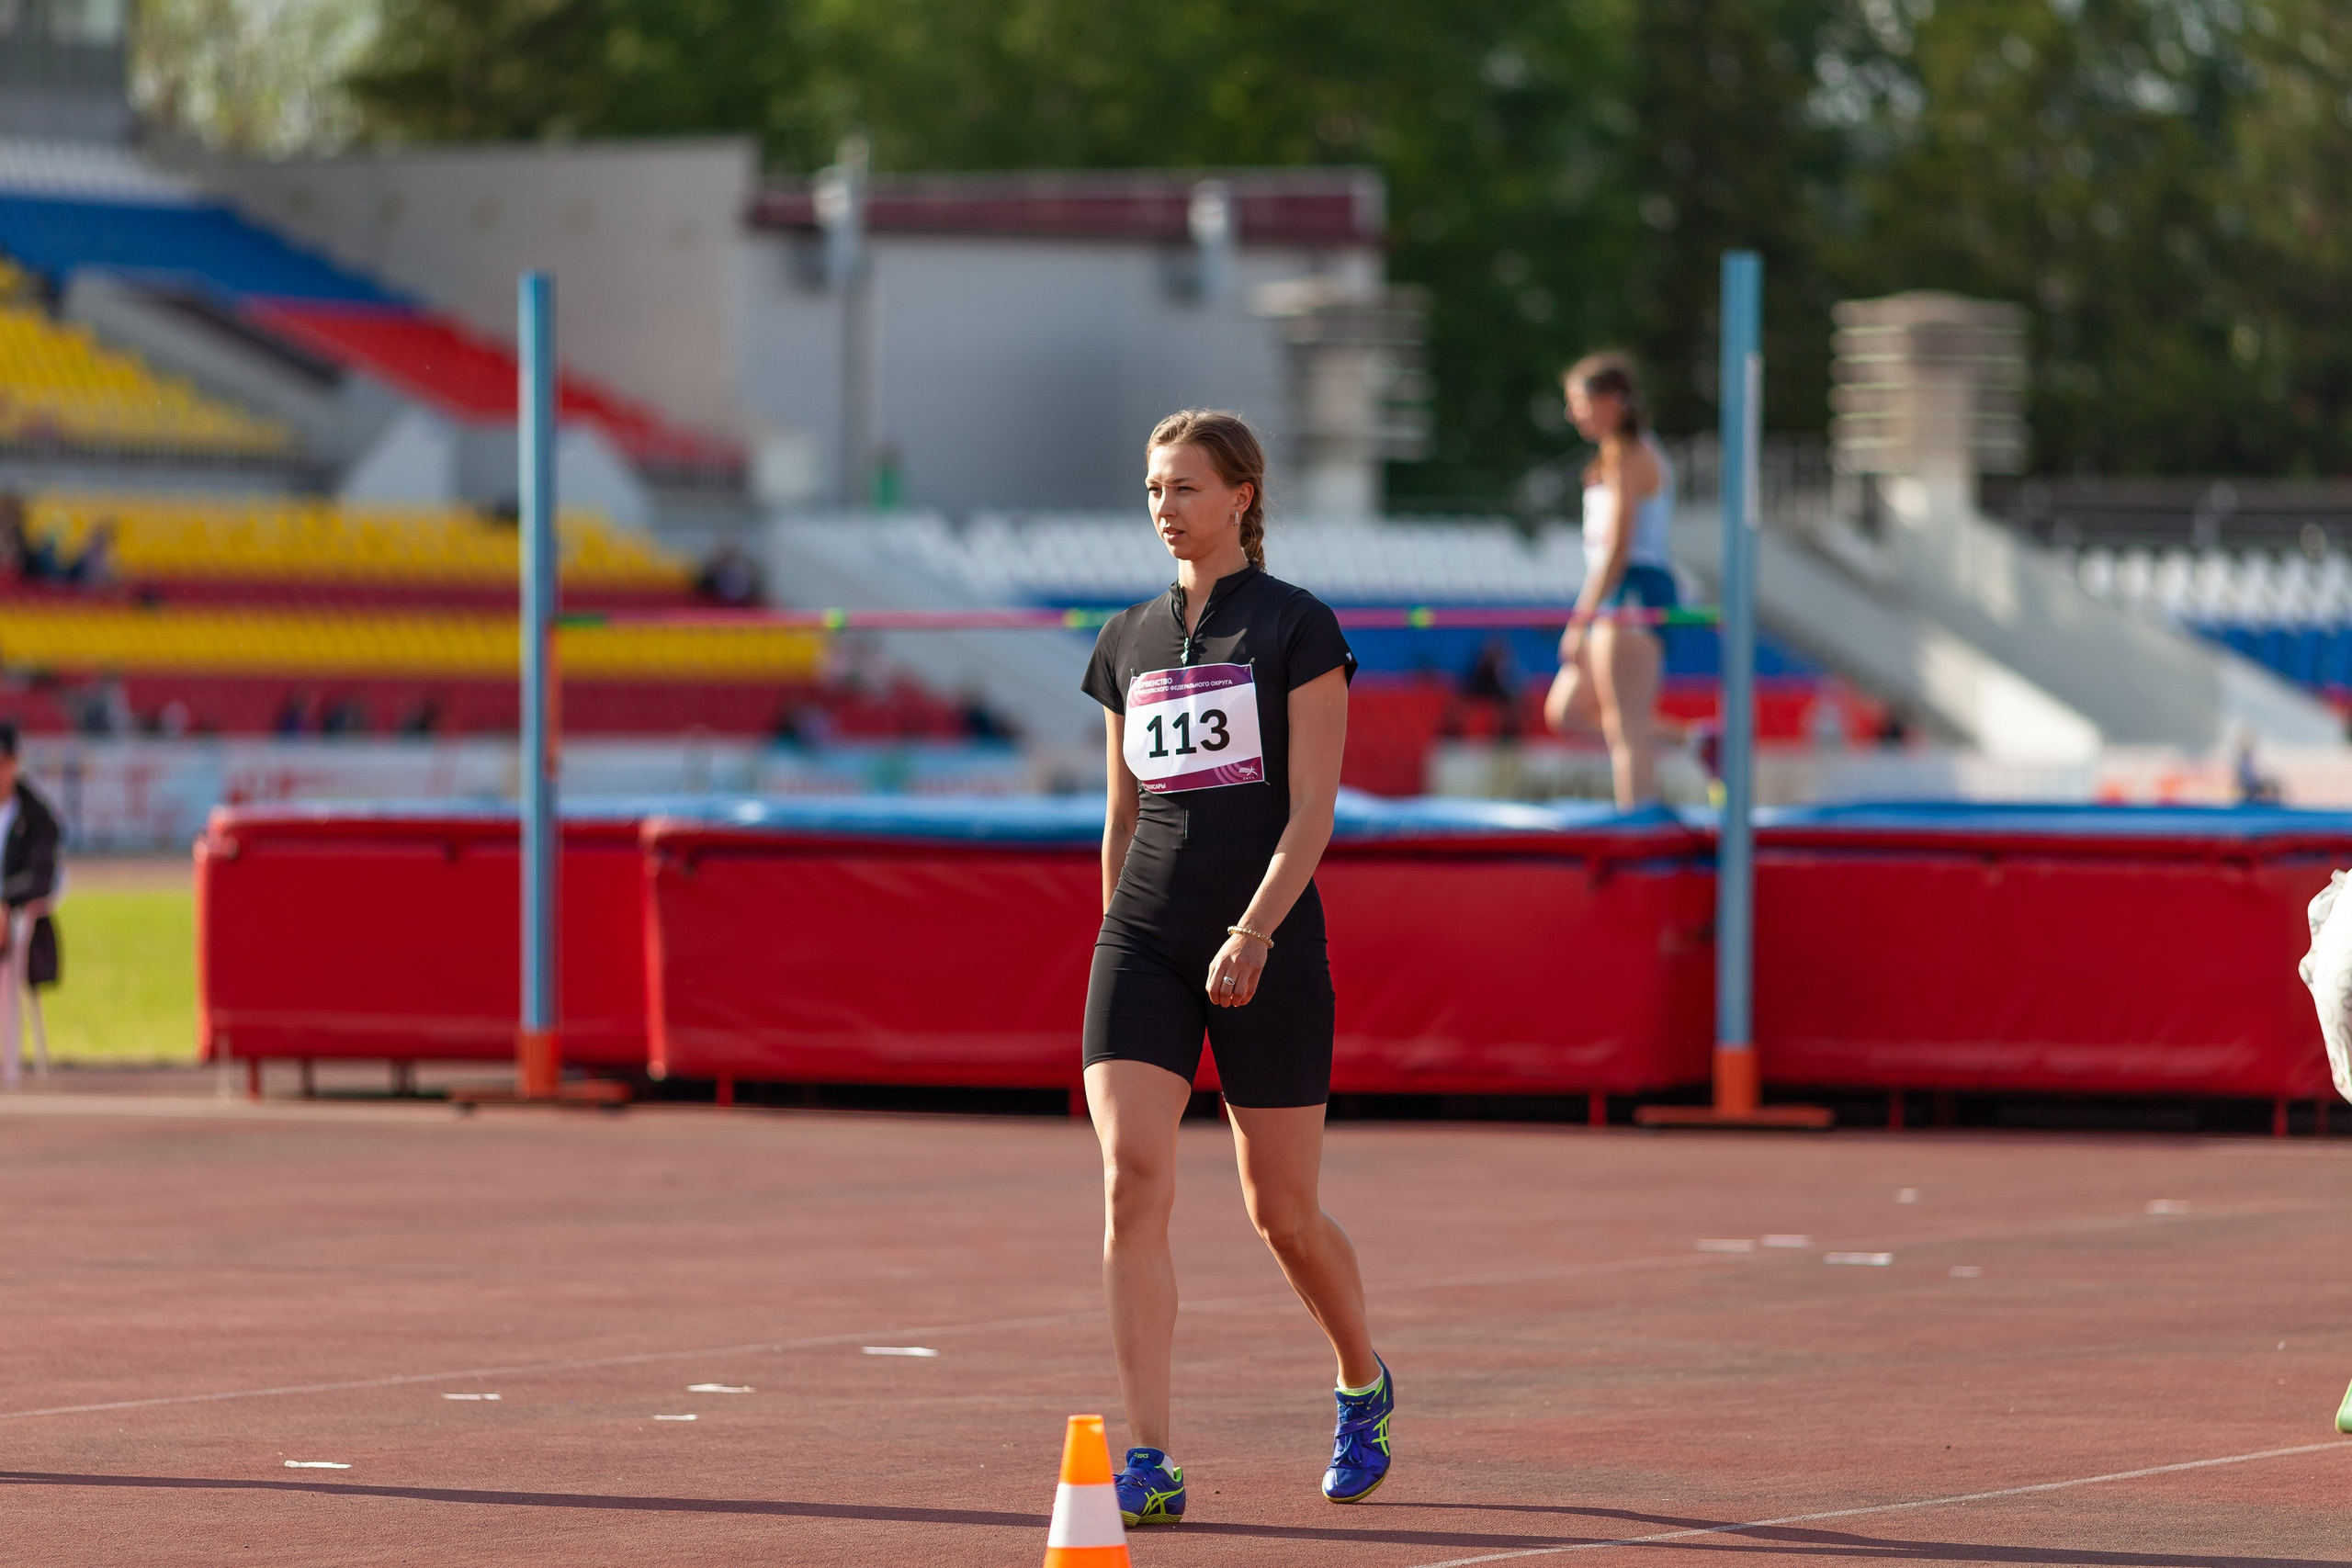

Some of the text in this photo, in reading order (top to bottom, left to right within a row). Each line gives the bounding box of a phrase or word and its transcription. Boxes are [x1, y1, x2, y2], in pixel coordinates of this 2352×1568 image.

[1170, 680, 1210, 691] ФЕДЕРАЛЬНОГО
[1210, 679, 1233, 687] ОКРУГА
[1147, 708, 1230, 759] 113
